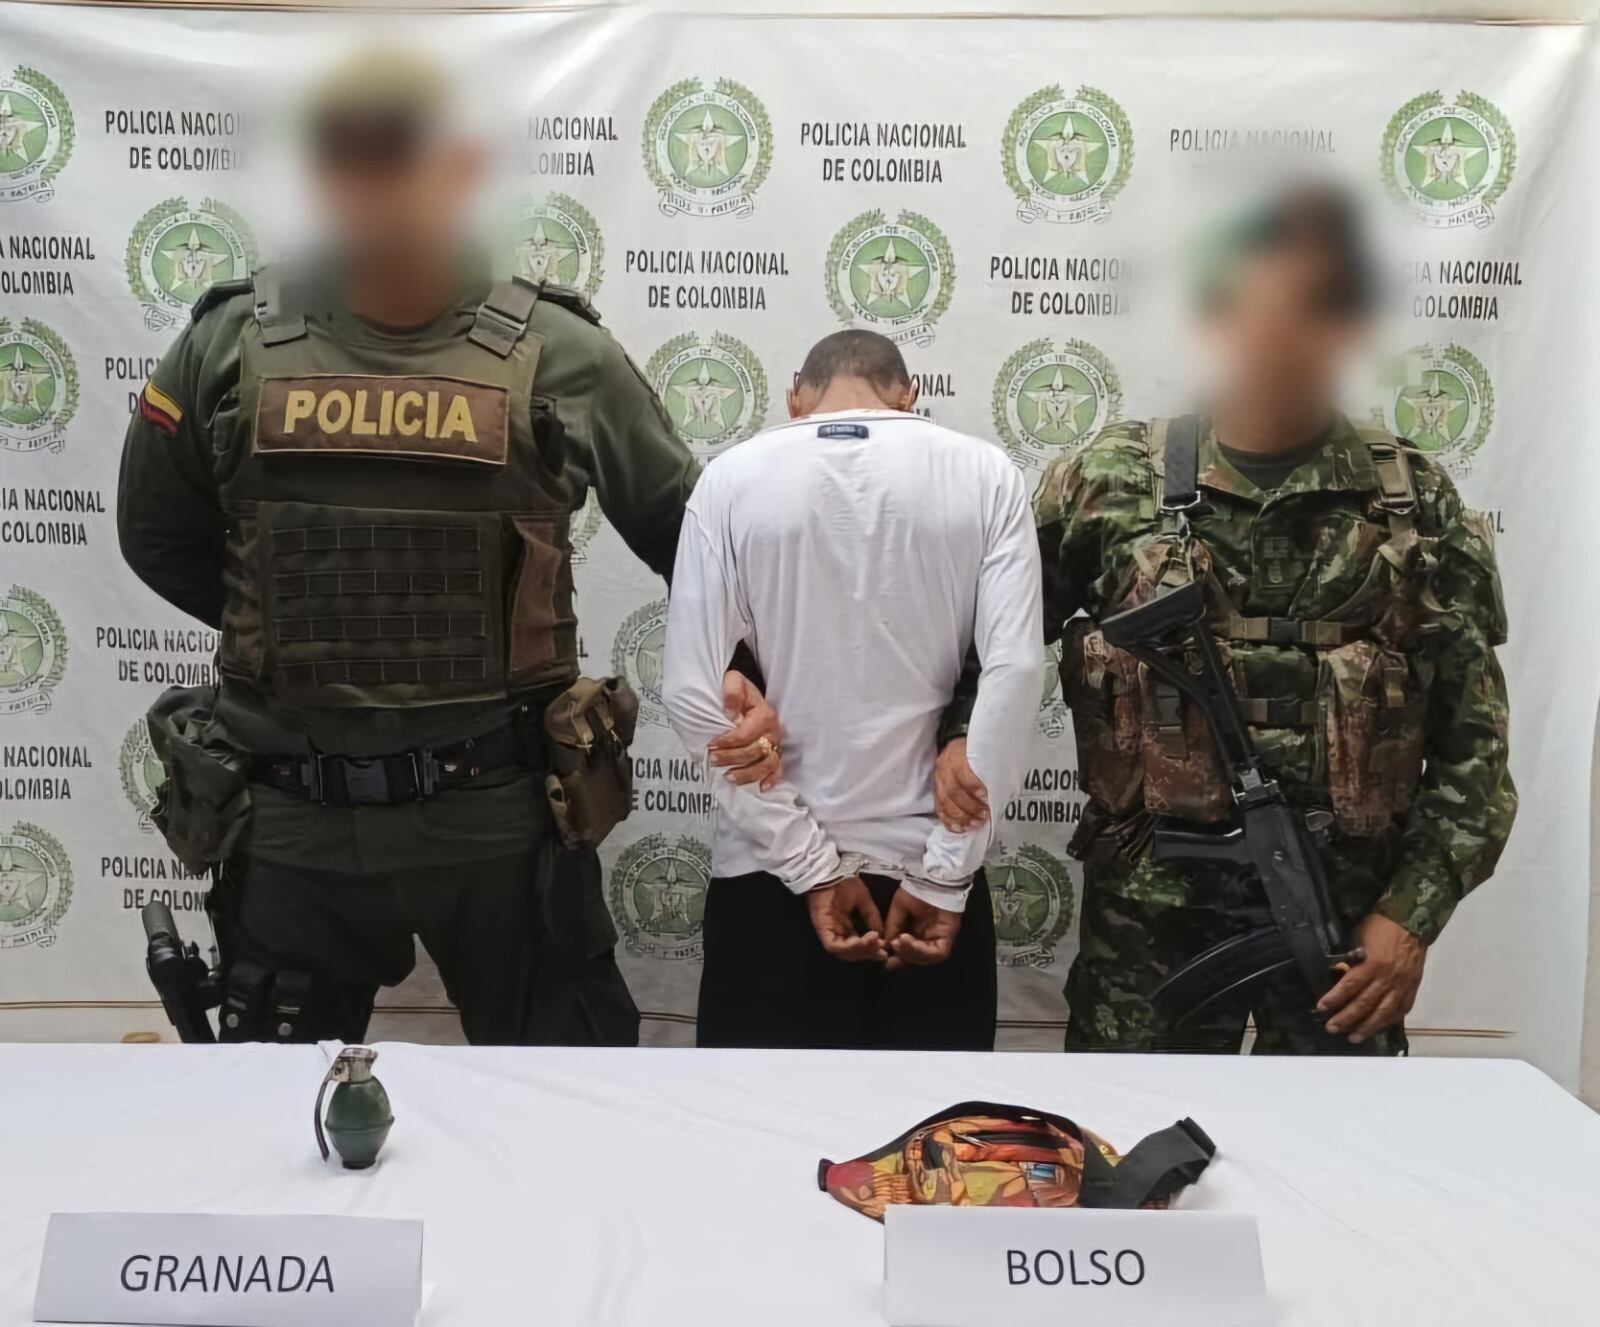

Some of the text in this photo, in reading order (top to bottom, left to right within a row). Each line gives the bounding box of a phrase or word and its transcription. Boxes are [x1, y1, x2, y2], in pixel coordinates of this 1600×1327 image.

[105, 110, 239, 136] POLICIA NACIO
[800, 122, 966, 149] POLICIA NACIONAL
[129, 146, 237, 171] DE COLOMBI
[530, 151, 595, 176] OMBIA
[823, 158, 943, 183] DE COLOMBIA
[9, 235, 95, 260] NACIONAL
[626, 249, 789, 276] POLICIA NACIONAL
[990, 256, 1126, 282] POLICIA NACIO
[1439, 260, 1522, 286] NACIONAL
[1, 270, 74, 297] OLOMBIA
[648, 285, 766, 310] DE COLOMBIA
[1011, 291, 1123, 316] DE COLOMBI
[105, 357, 155, 380] POLIC
[283, 389, 479, 443] POLICIA
[24, 488, 105, 513] NACIONAL
[2, 520, 88, 546] COLOMBIA
[96, 626, 216, 653] POLICIA NACIO
[119, 659, 211, 687] DE COLOMB
[4, 745, 92, 768] NACIONAL
[0, 777, 71, 800] LOMBIA
[644, 789, 712, 815] COLOMB
[1005, 799, 1081, 823] OLOMBIA
[101, 855, 167, 879] POLICIA
[123, 888, 145, 909] DE
[120, 1254, 335, 1294] GRANADA
[1006, 1249, 1146, 1286] BOLSO
